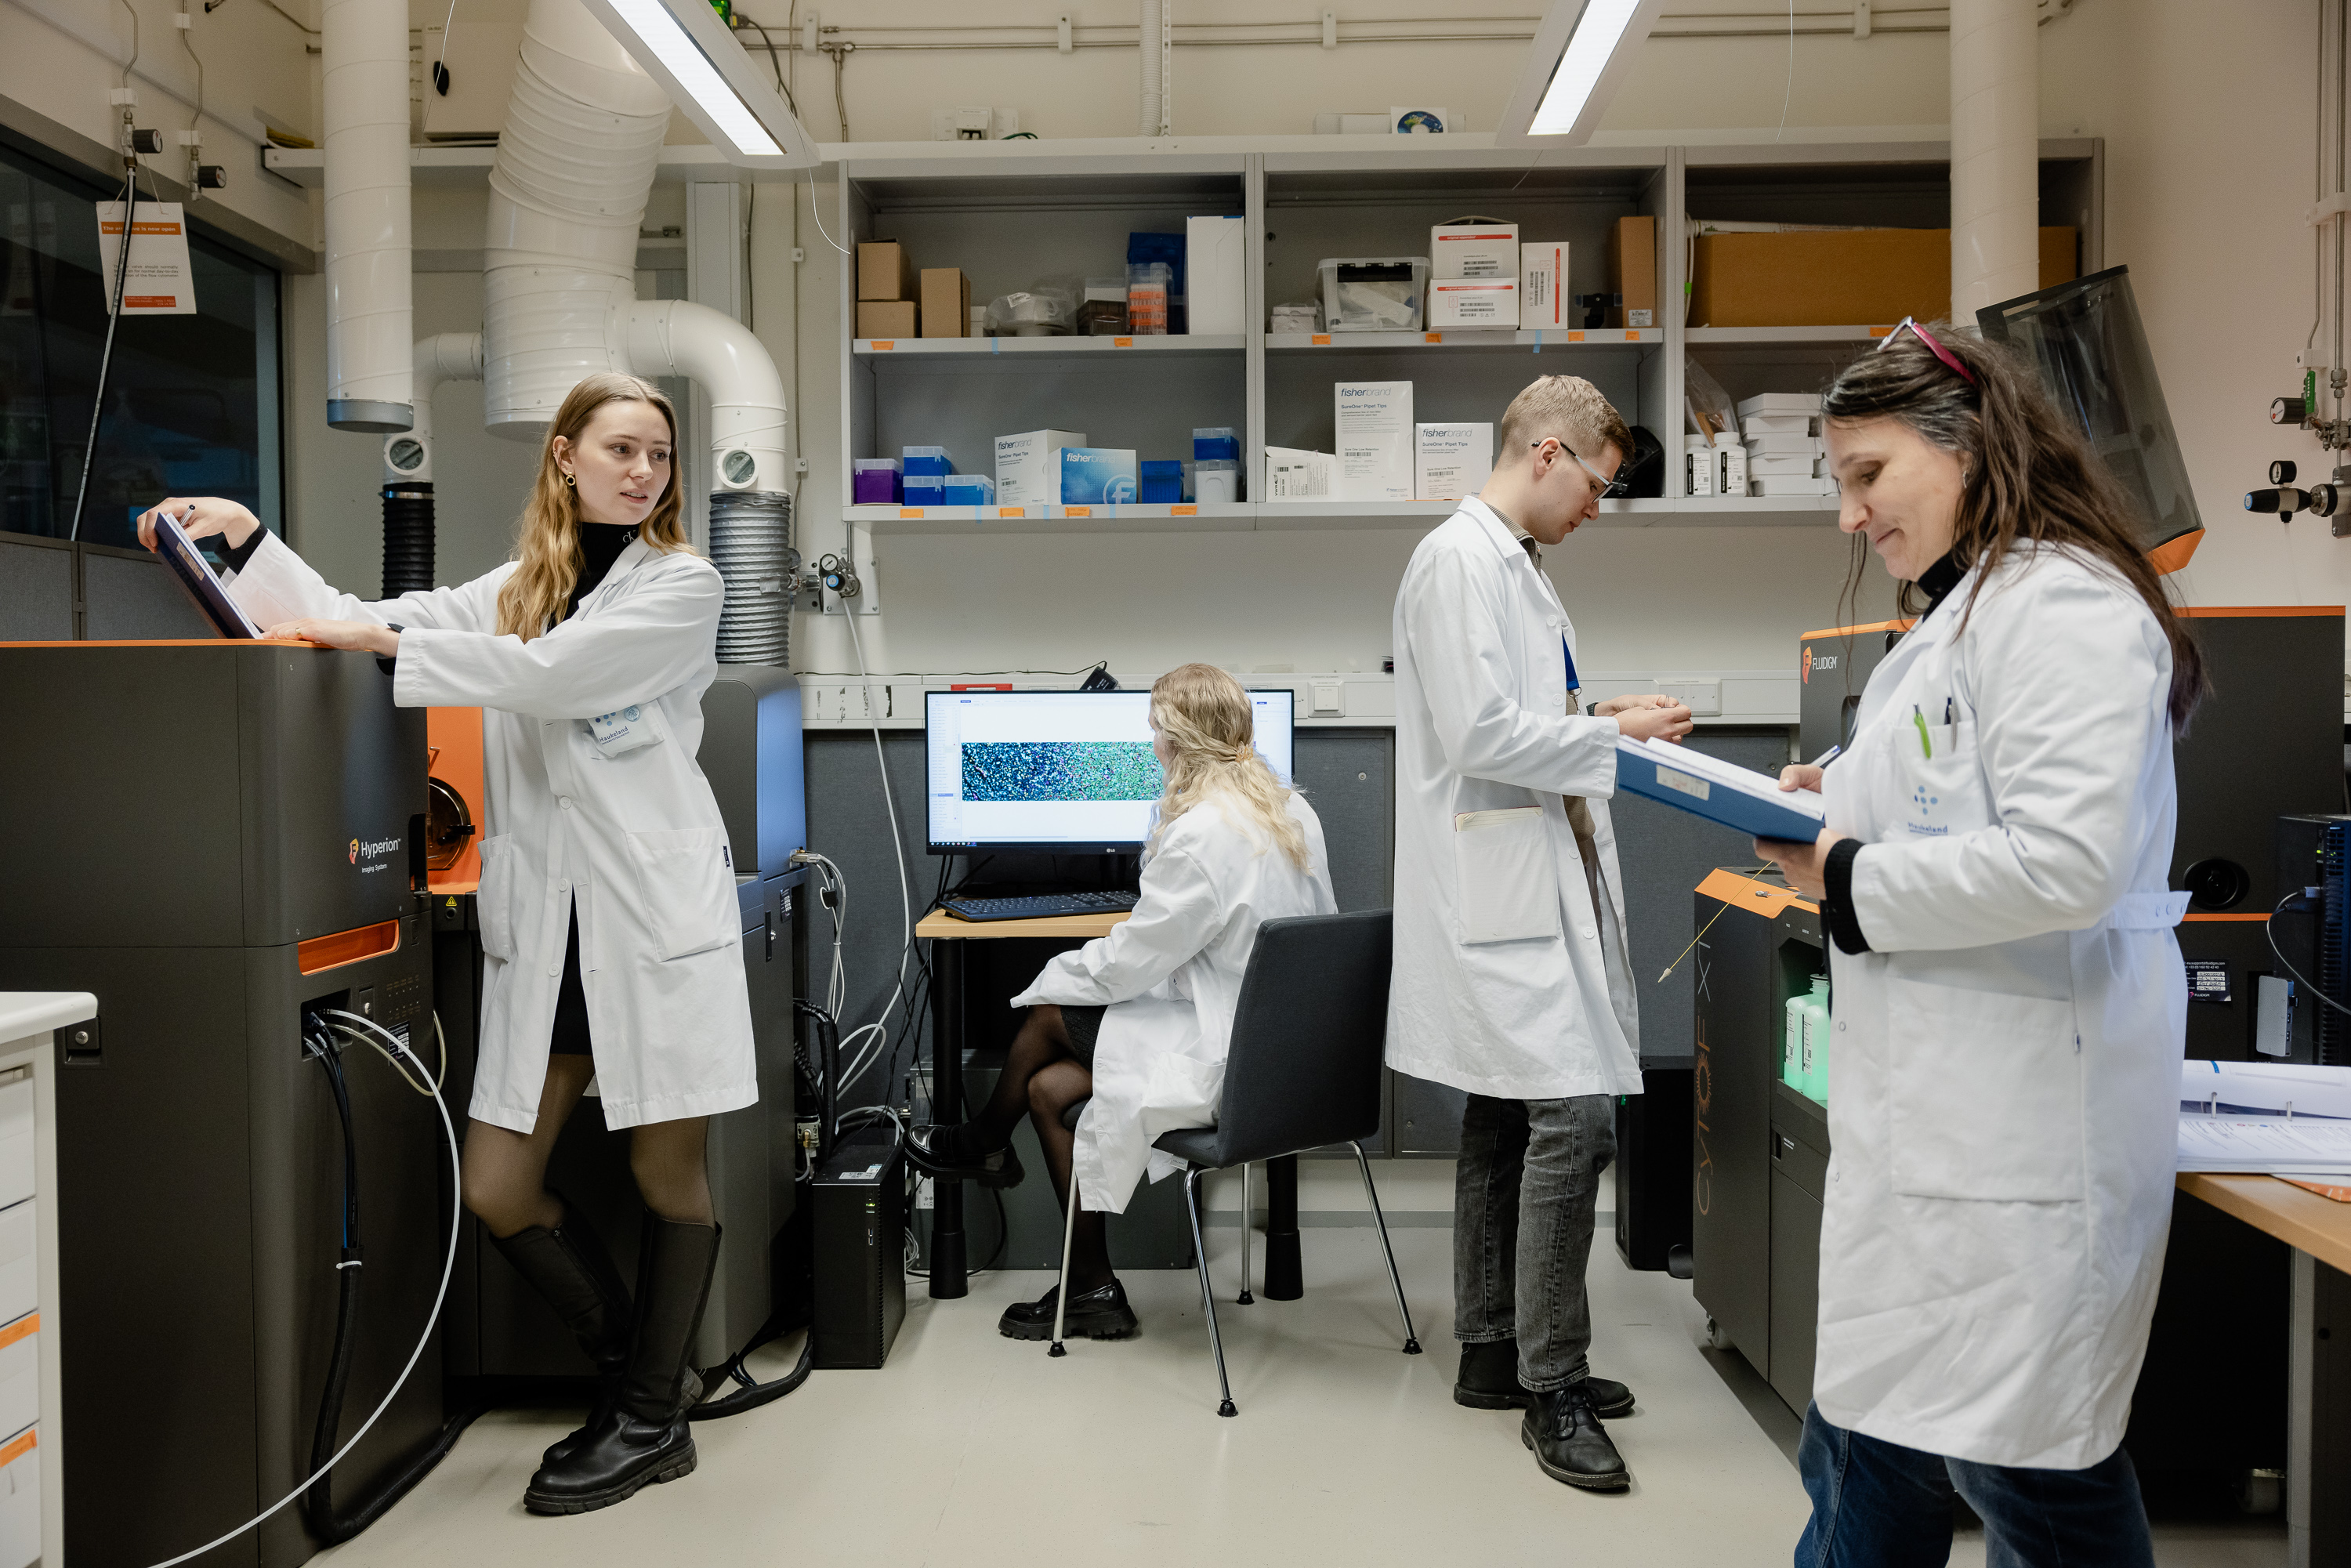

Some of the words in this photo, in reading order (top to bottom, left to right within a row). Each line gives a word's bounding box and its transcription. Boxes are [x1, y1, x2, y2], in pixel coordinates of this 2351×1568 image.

[1341, 387, 1392, 397] fisherbrand
[1422, 429, 1473, 437] fisherbrand
[998, 437, 1032, 450] fisherbrand
[1067, 452, 1116, 463] fisherbrand
[1813, 656, 1838, 670] FLUIDIGM
[598, 726, 629, 743] Haukeland
[361, 865, 375, 874] Imaging
